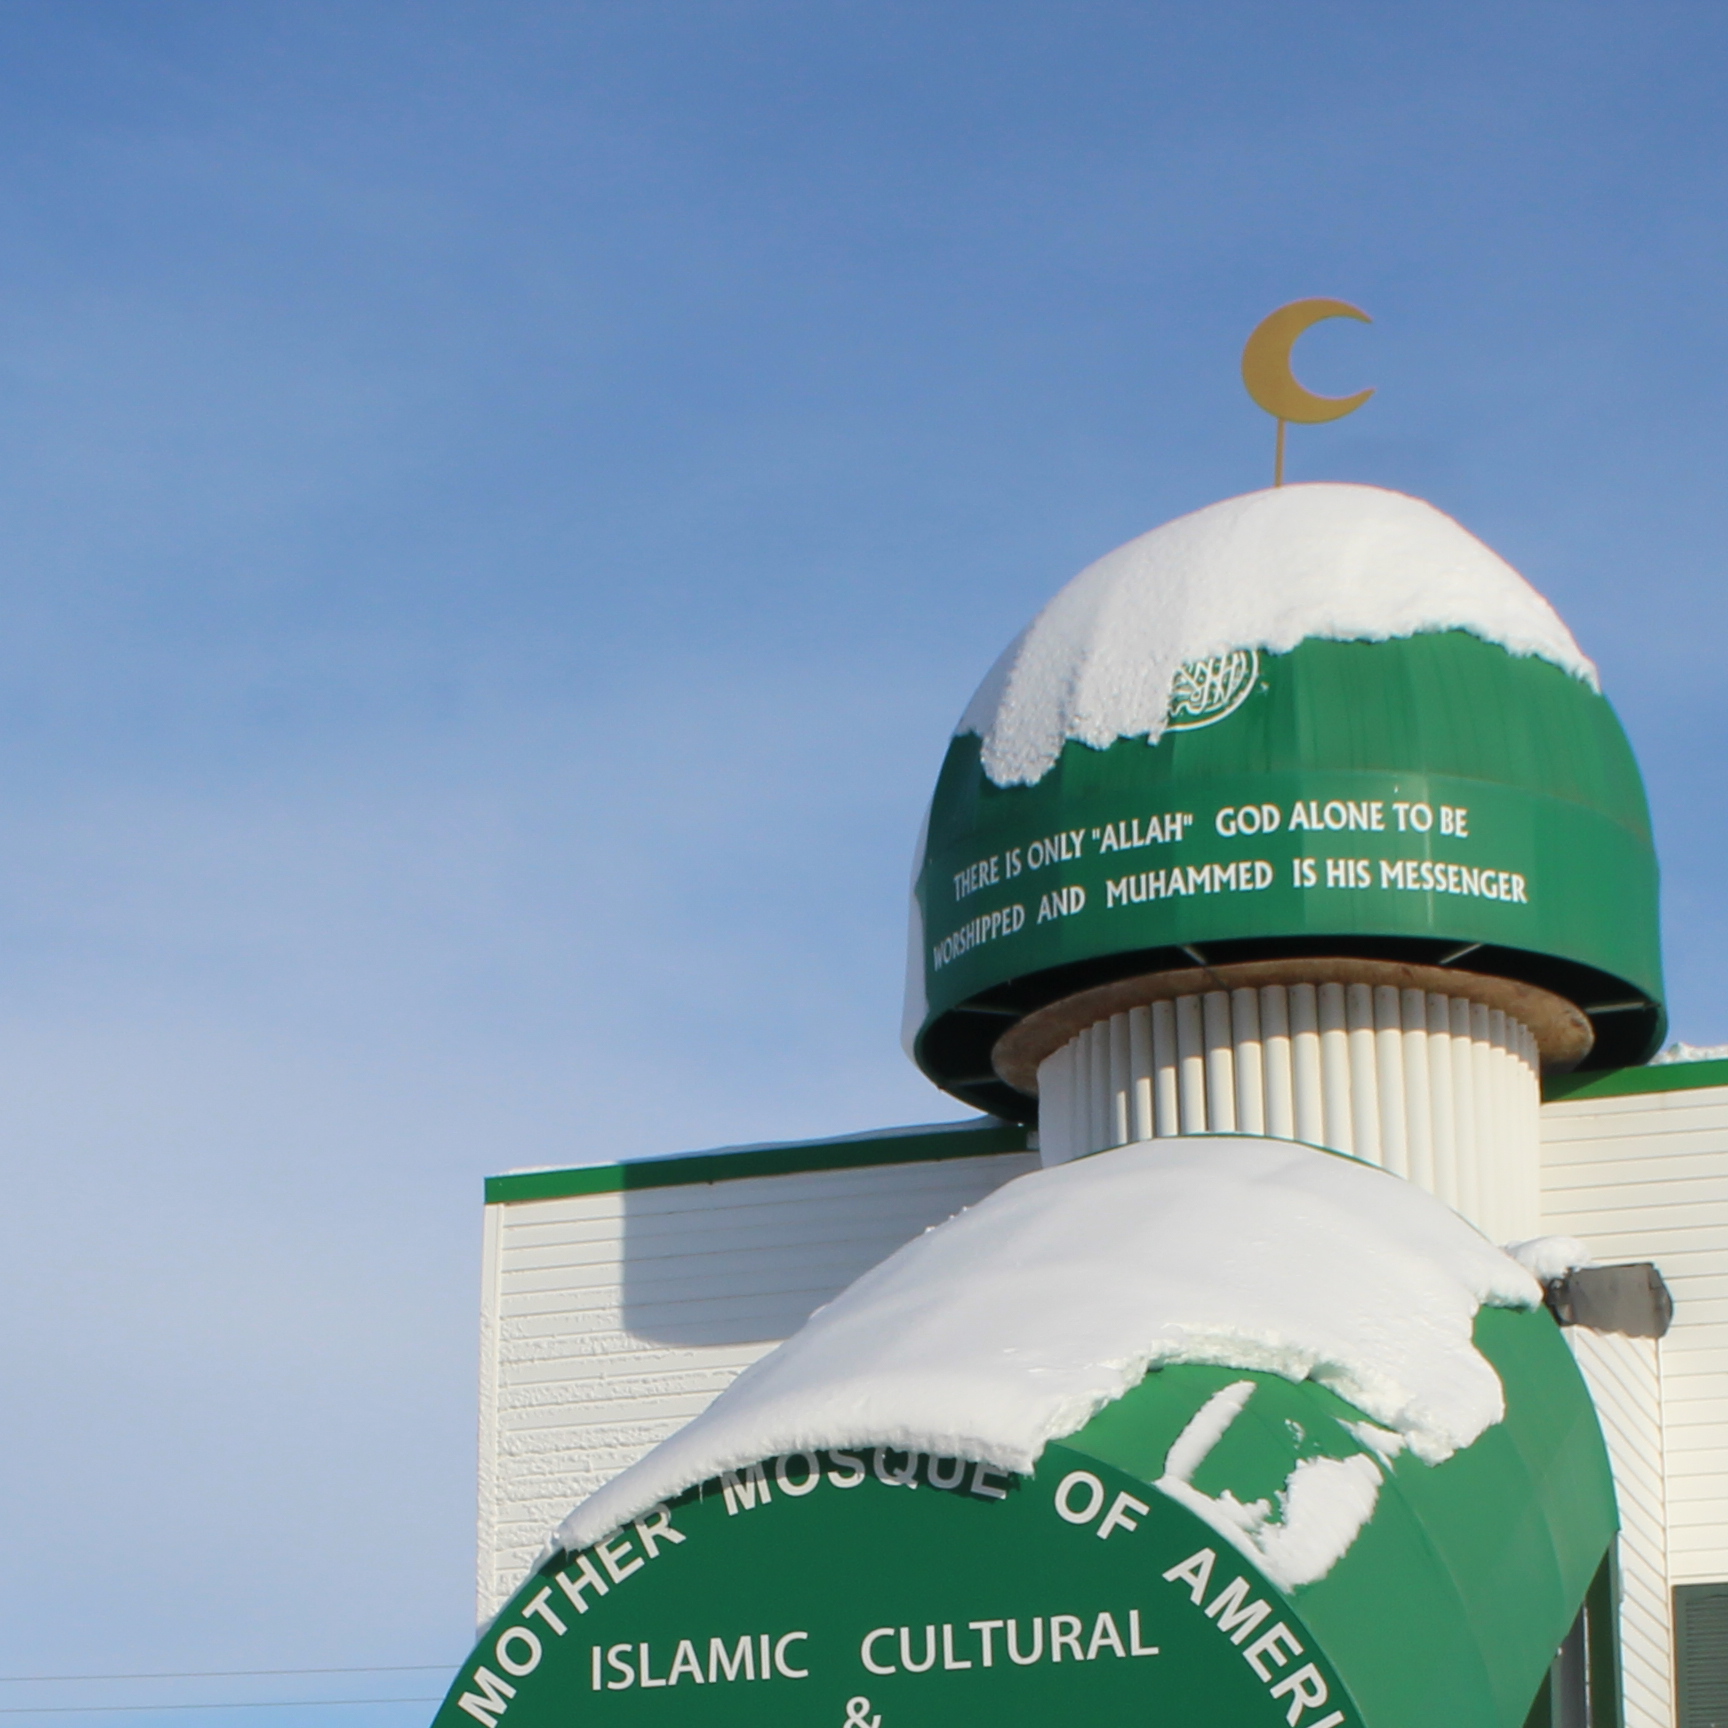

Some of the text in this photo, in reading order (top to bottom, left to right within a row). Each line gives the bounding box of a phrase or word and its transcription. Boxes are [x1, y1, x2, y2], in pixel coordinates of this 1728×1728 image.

[953, 800, 1469, 901] THERE IS ONLY "ALLAH" GOD ALONE TO BE
[933, 857, 1528, 972] WORSHIPPED AND MUHAMMED IS HIS MESSENGER
[720, 1447, 1008, 1516] MOSQUE
[1054, 1470, 1151, 1540] OF
[591, 1609, 1160, 1691] ISLAMIC CULTURAL
